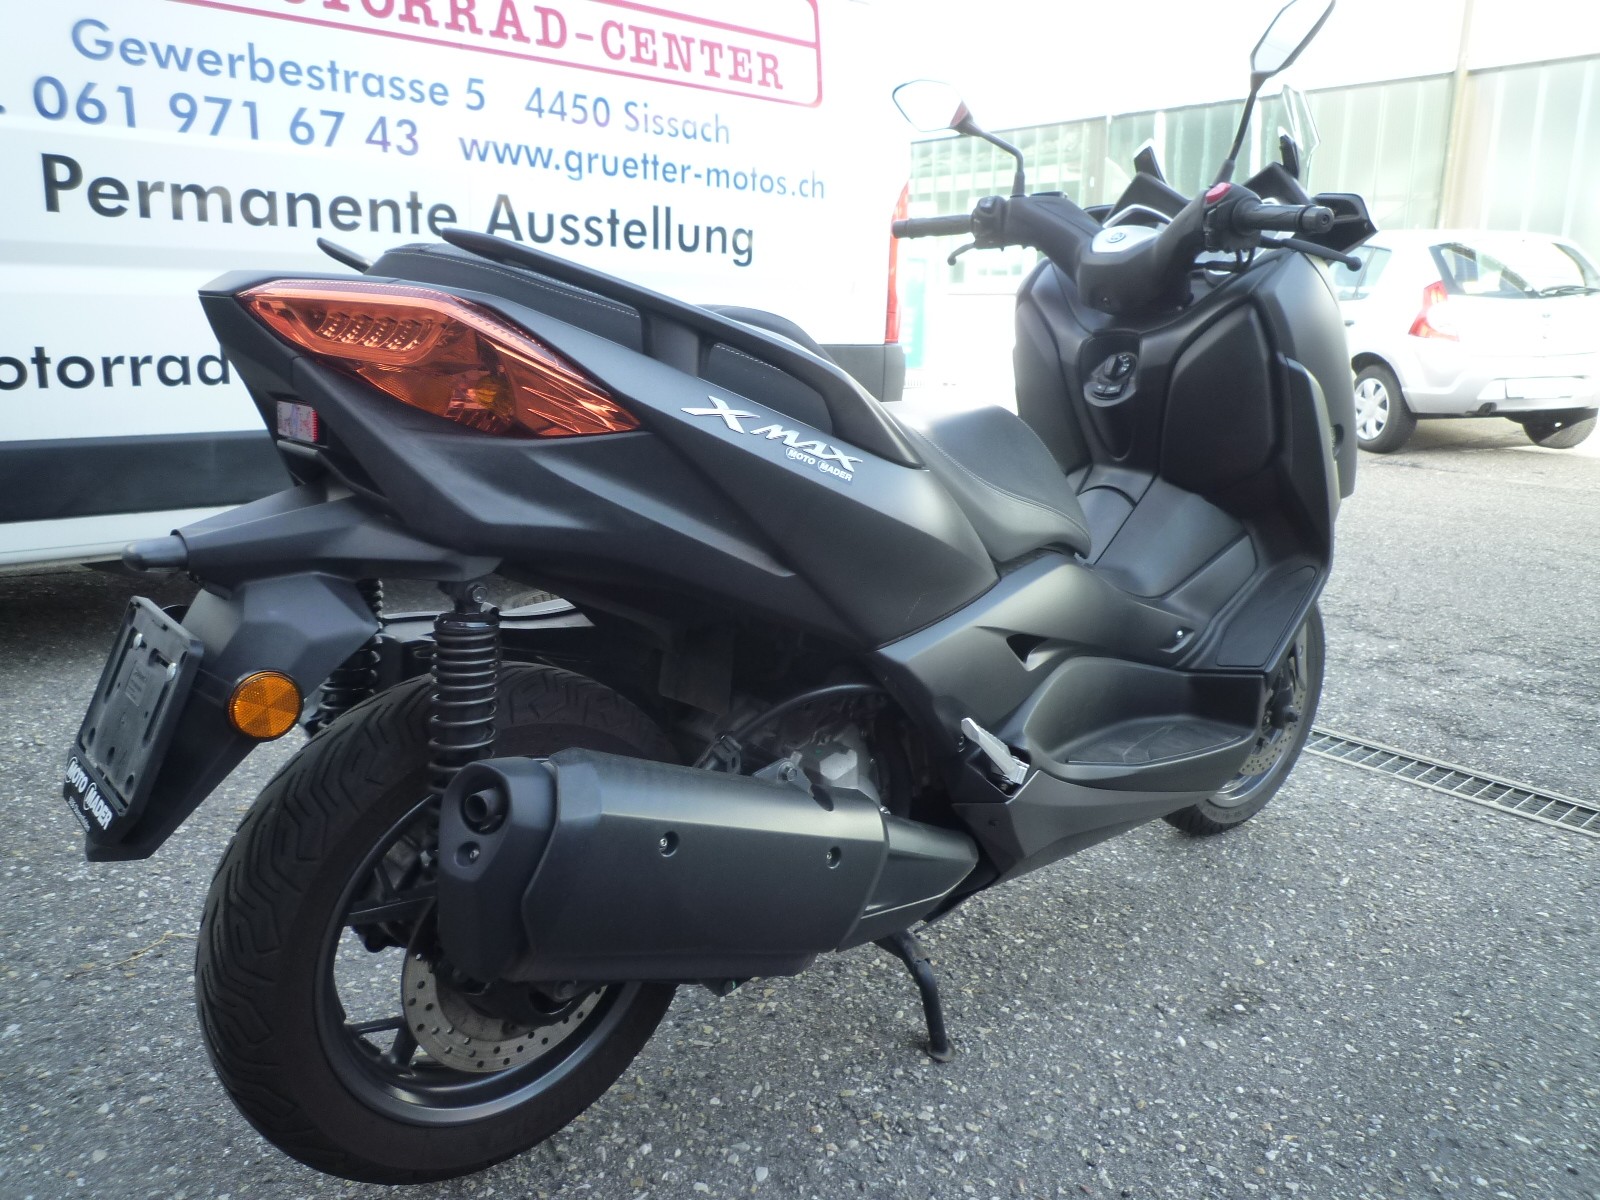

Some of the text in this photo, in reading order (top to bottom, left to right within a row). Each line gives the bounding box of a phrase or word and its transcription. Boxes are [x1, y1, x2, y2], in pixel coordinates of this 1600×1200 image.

[71, 18, 730, 144] Gewerbestrasse 5 4450 Sissach
[283, 0, 784, 90] RRAD-CENTER
[33, 75, 825, 199] 061 971 67 43 www.gruetter-motos.ch
[41, 152, 753, 267] Permanente Ausstellung
[786, 447, 852, 481] MOTO MADER
[66, 757, 88, 793] MOTO
[84, 783, 113, 830] MADER
